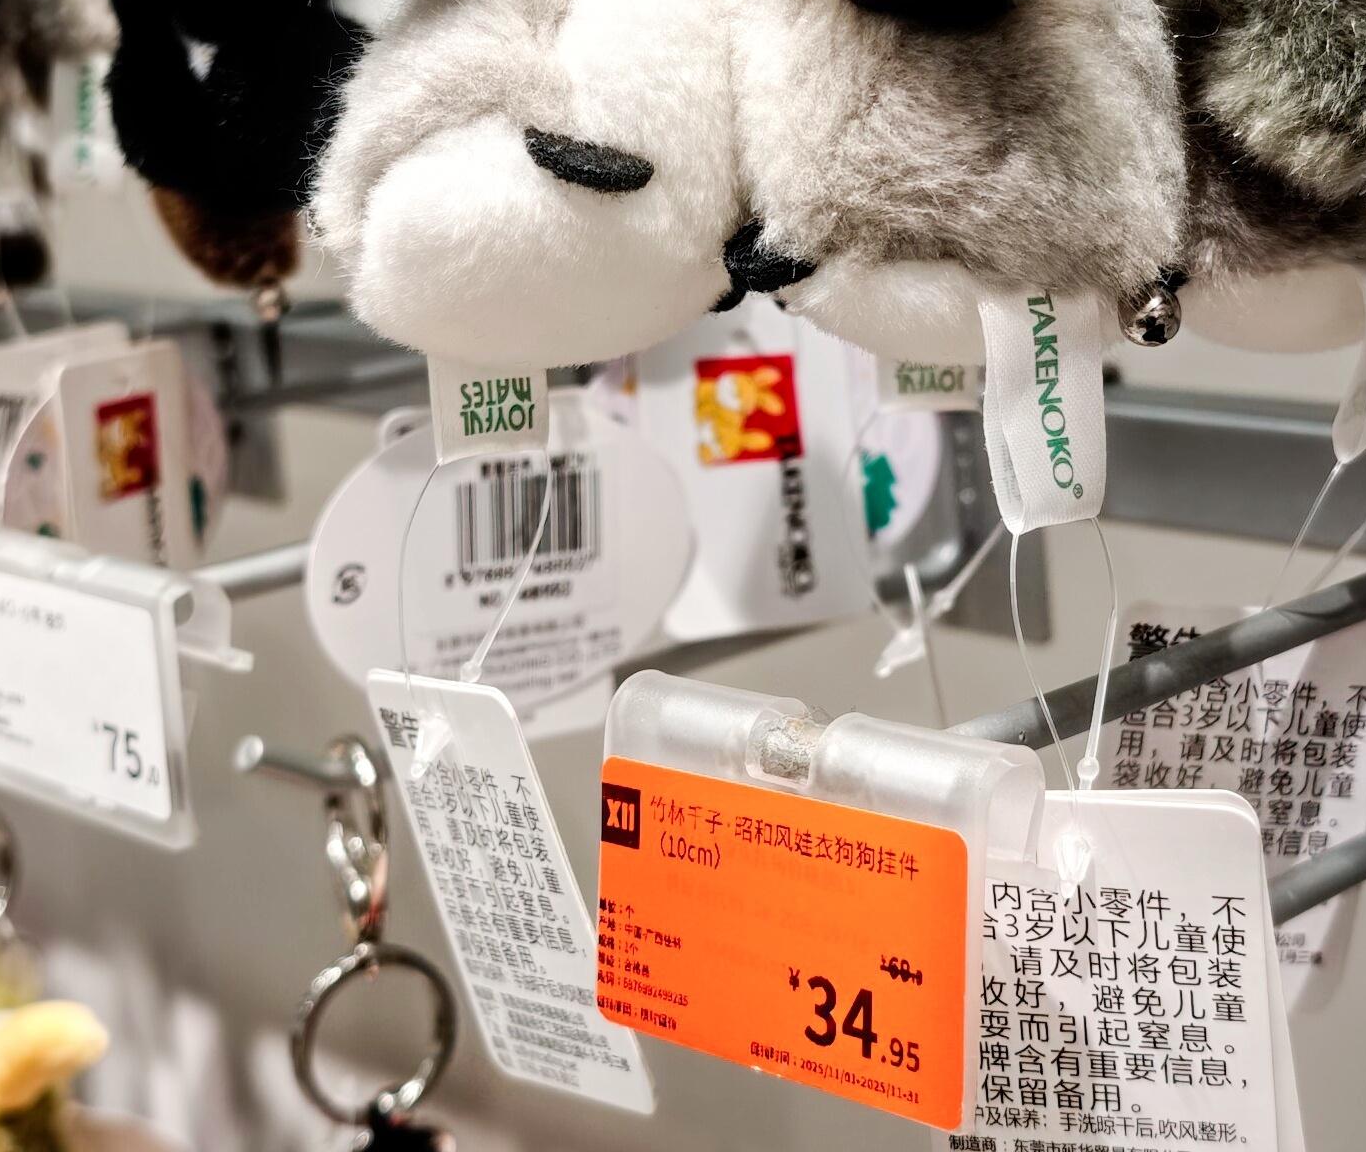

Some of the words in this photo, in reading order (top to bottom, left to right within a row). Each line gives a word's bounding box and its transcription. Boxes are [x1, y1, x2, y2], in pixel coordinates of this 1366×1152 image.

[460, 376, 532, 410] MATES
[459, 403, 536, 437] JOYFUL
[789, 967, 920, 1072] ¥34.95
[980, 1010, 1236, 1056] 耍而引起窒息。
[979, 1042, 1248, 1089] 牌含有重要信息，
[981, 1074, 1142, 1115] 保留备用。
